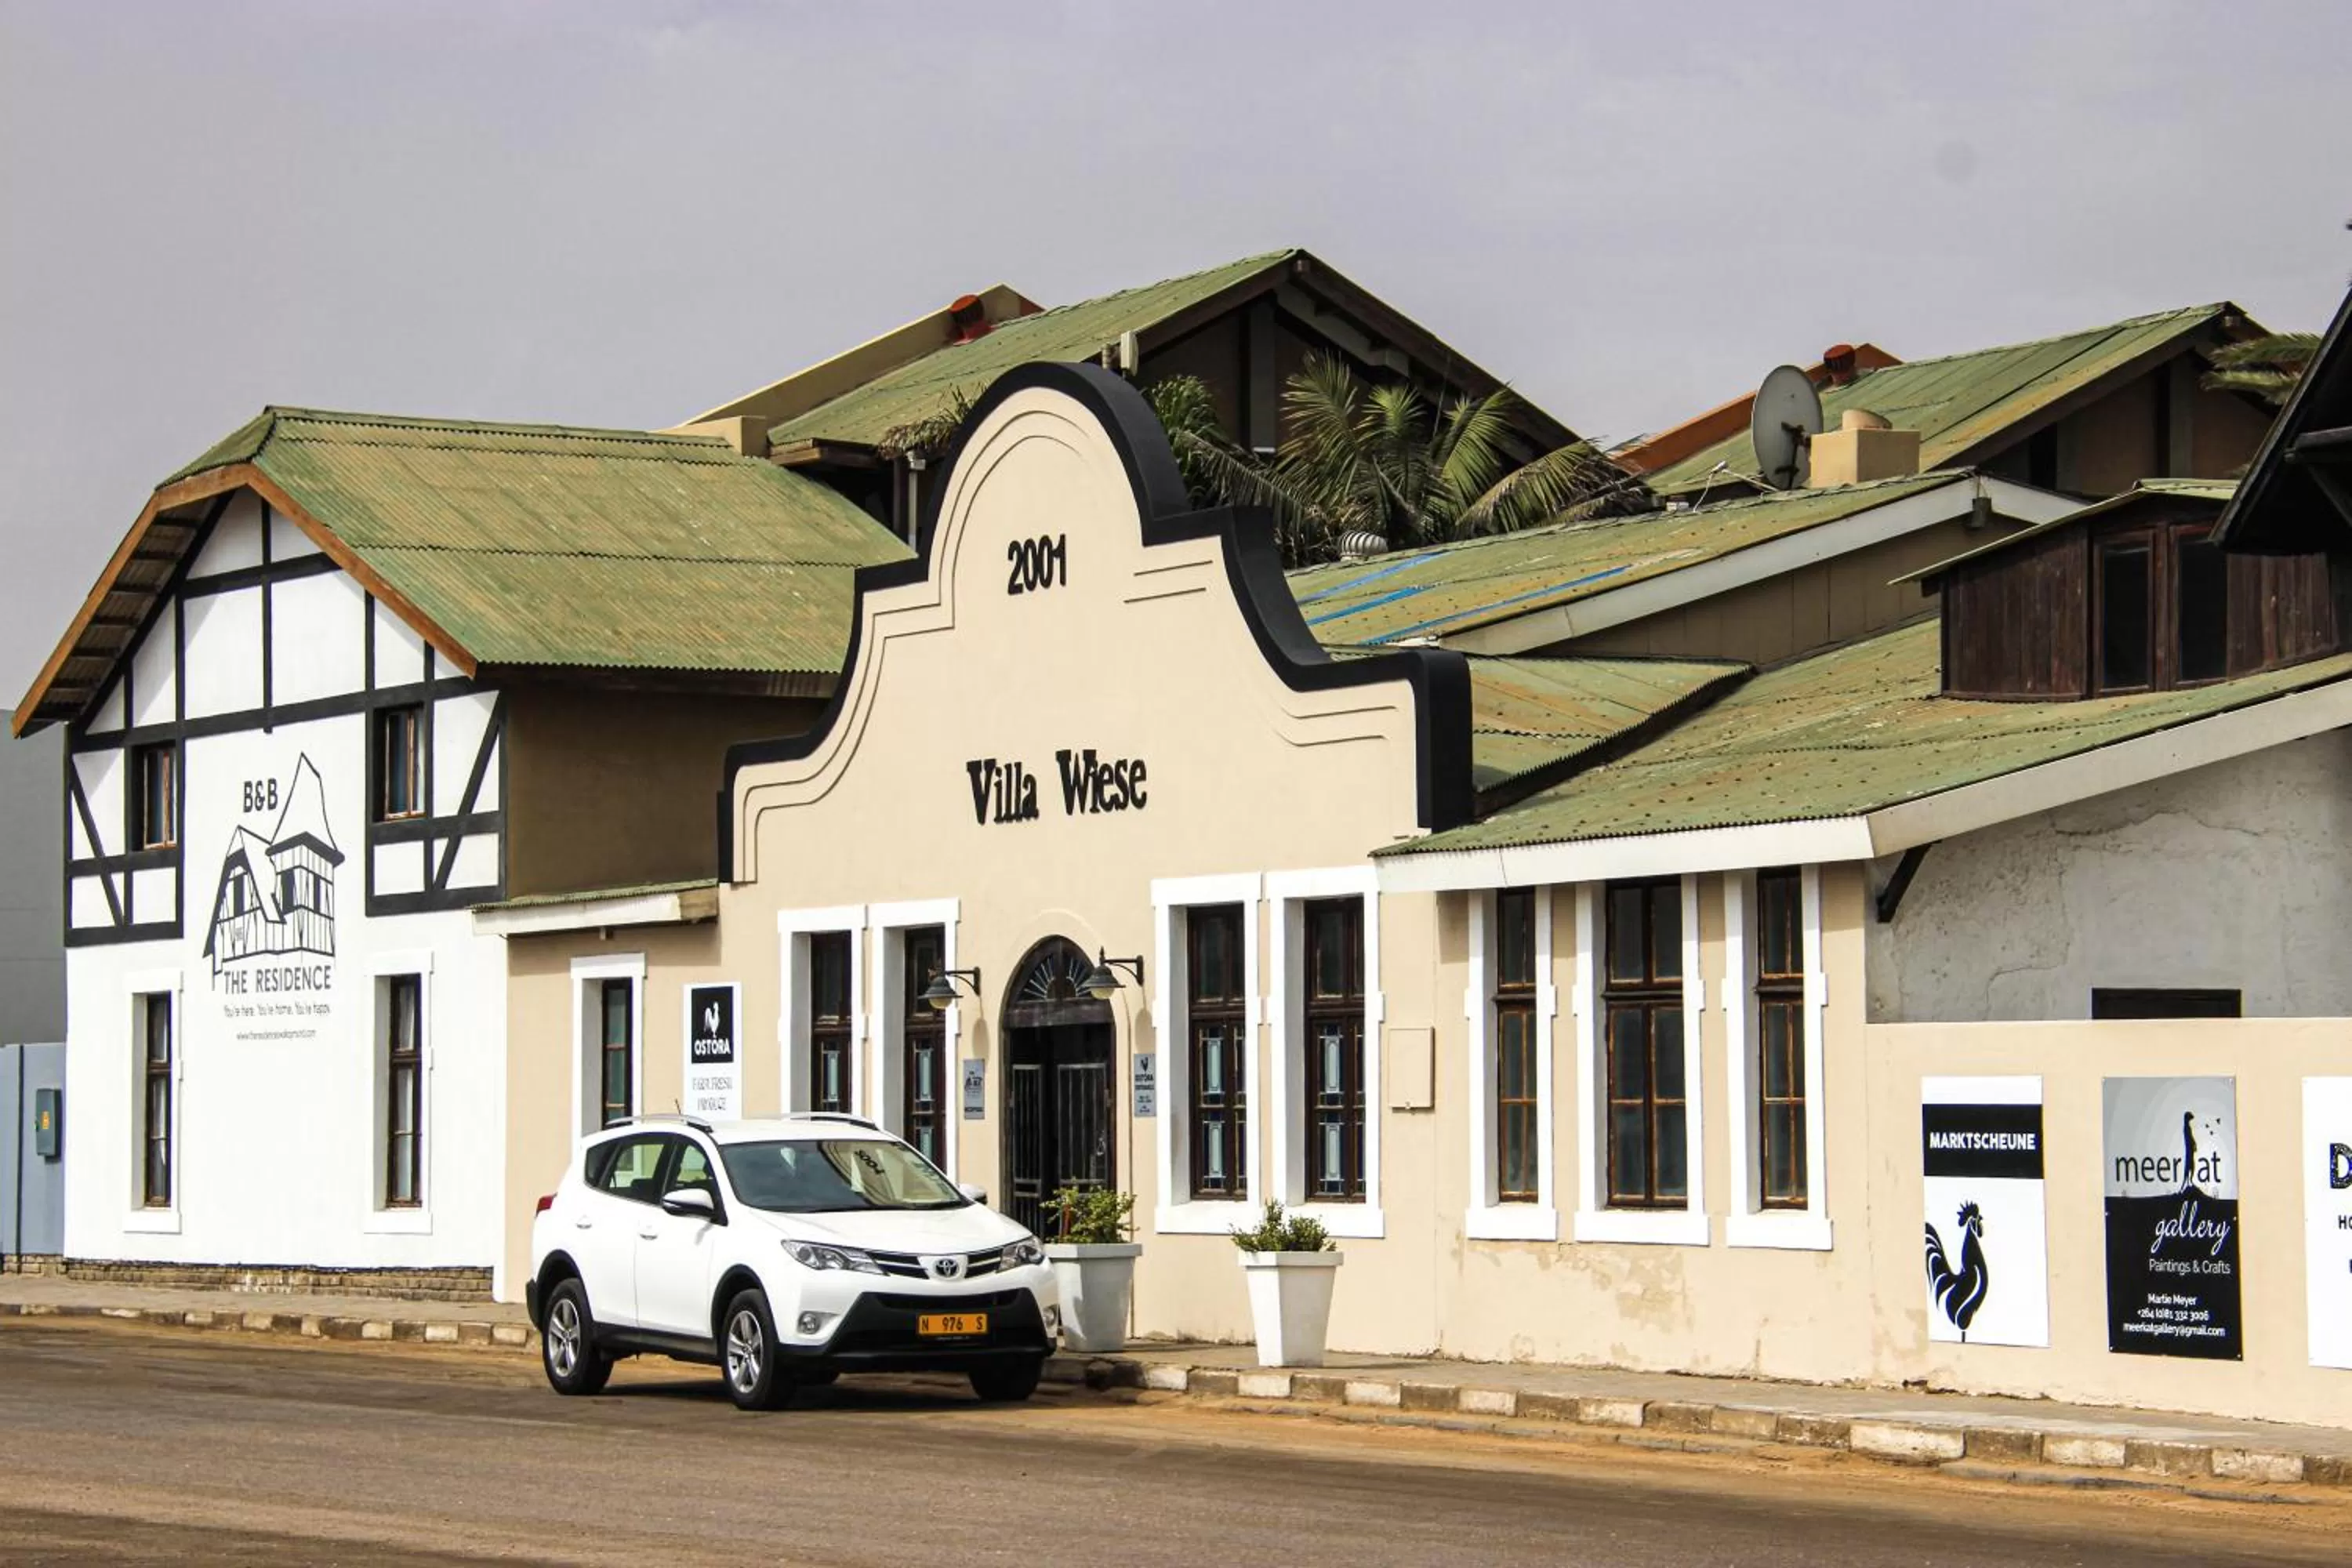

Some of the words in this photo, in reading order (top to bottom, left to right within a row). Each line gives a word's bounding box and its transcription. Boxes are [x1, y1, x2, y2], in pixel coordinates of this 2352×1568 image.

[1007, 534, 1066, 595] 2001
[243, 778, 278, 813] B&B
[967, 758, 1039, 826] Villa
[1055, 749, 1147, 816] Wiese
[223, 970, 248, 995] THE
[256, 965, 331, 994] RESIDENCE
[1929, 1131, 2036, 1149] MARKTSCHEUNE
[2115, 1150, 2221, 1183] meerat
[2151, 1200, 2230, 1255] gallery
[2149, 1258, 2190, 1275] Paintings
[2193, 1260, 2200, 1273] &
[2202, 1260, 2231, 1274] Crafts
[2173, 1294, 2198, 1308] Meyer
[922, 1317, 929, 1331] N
[942, 1316, 963, 1332] 976
[976, 1316, 983, 1330] S
